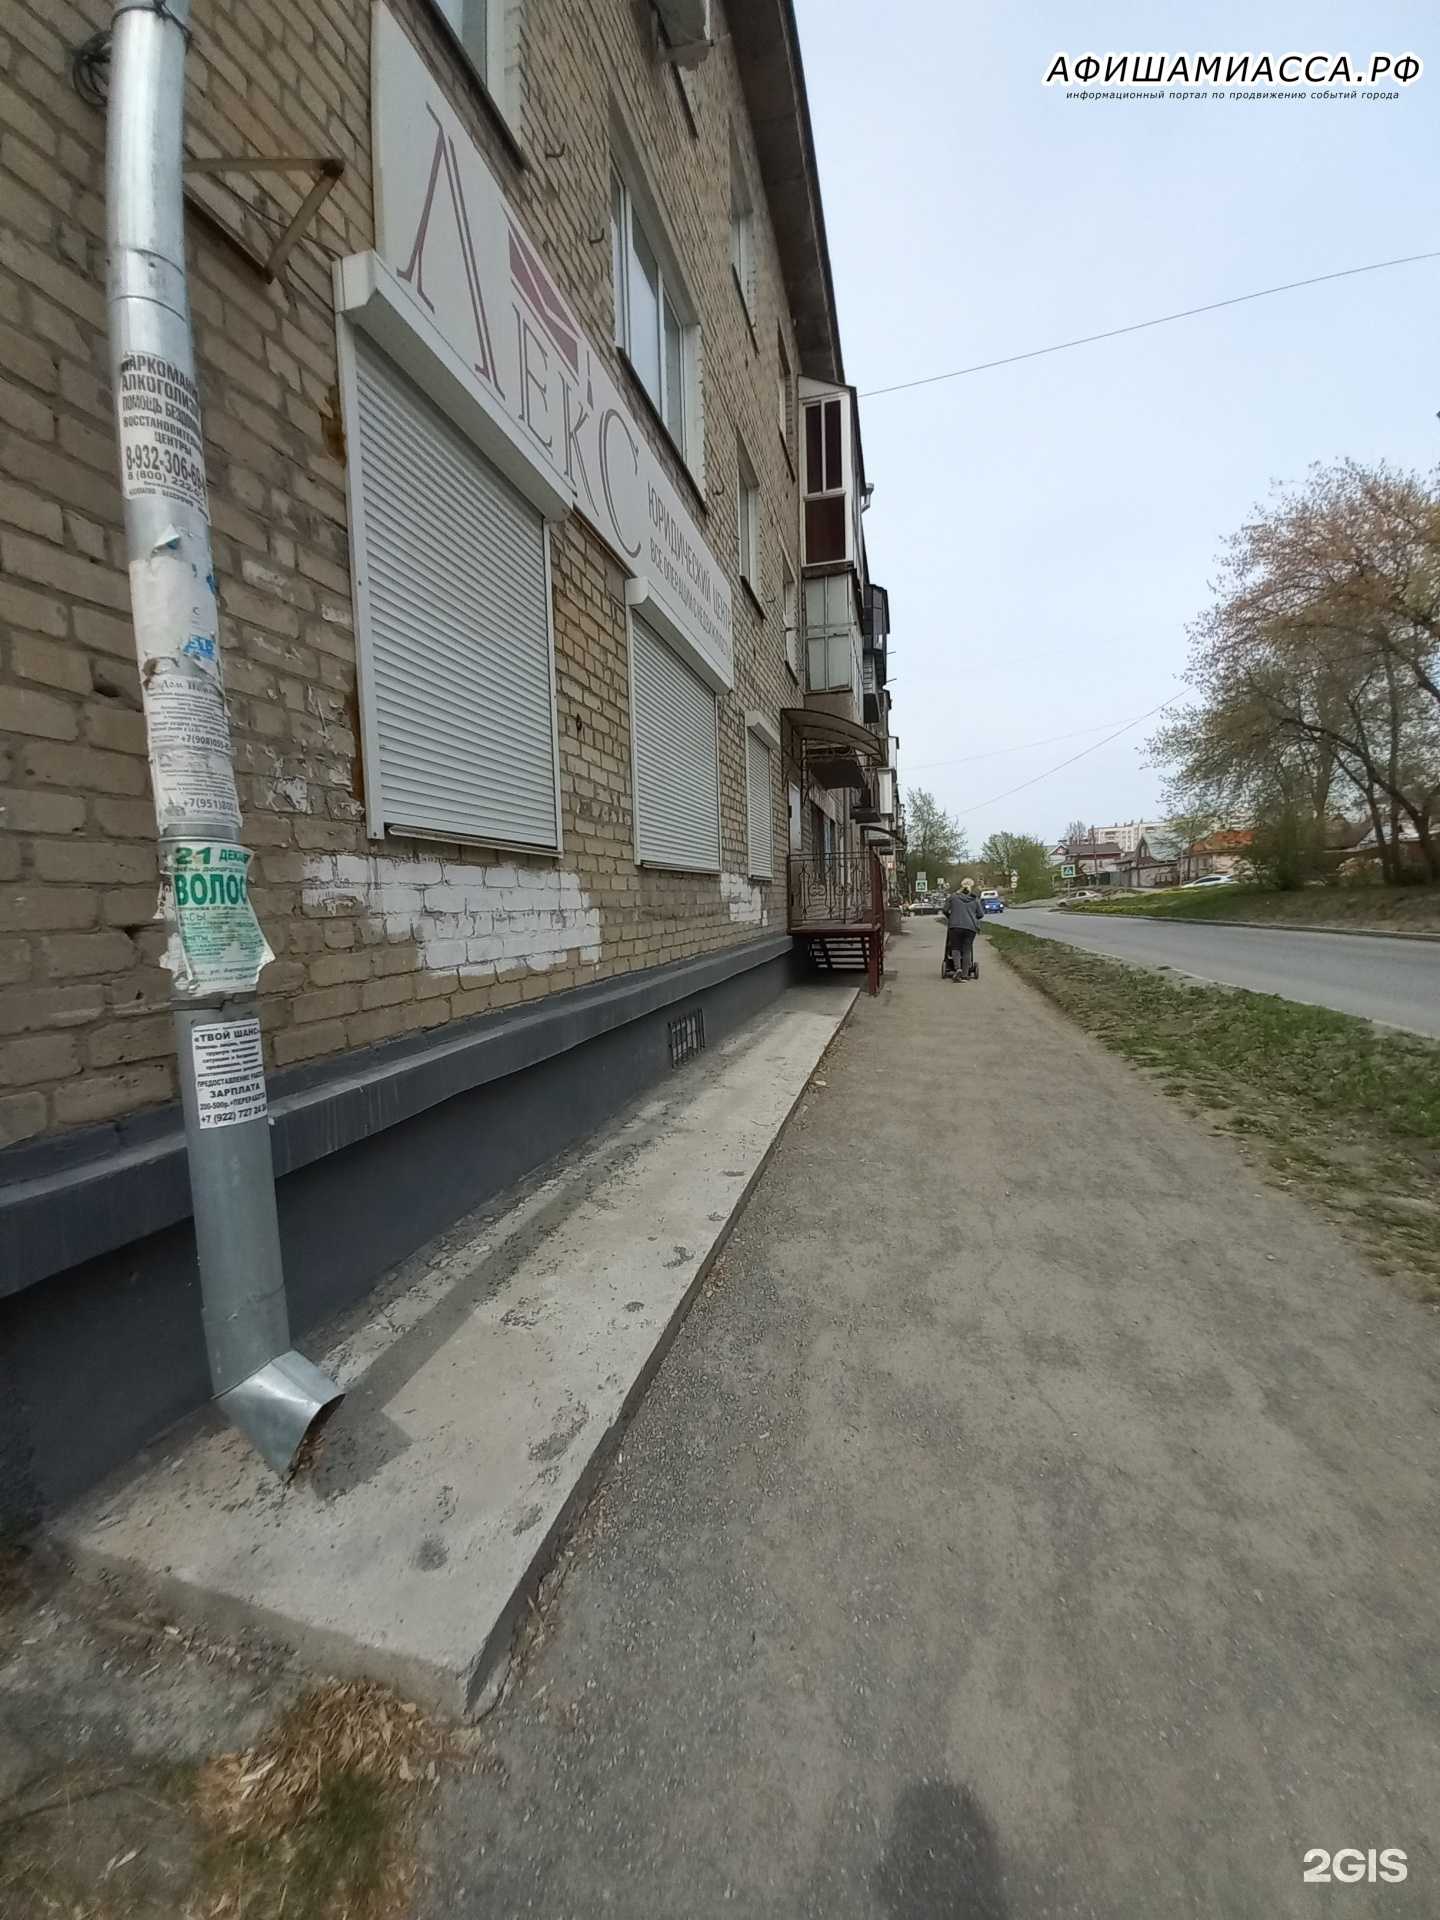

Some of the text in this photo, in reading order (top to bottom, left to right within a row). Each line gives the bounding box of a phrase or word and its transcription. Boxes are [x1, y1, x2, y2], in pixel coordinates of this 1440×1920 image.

[648, 479, 712, 607] ЮРИДИЧЕСКИЙ
[175, 847, 211, 865] 21
[209, 1082, 260, 1098] ЗАРПЛАТА
